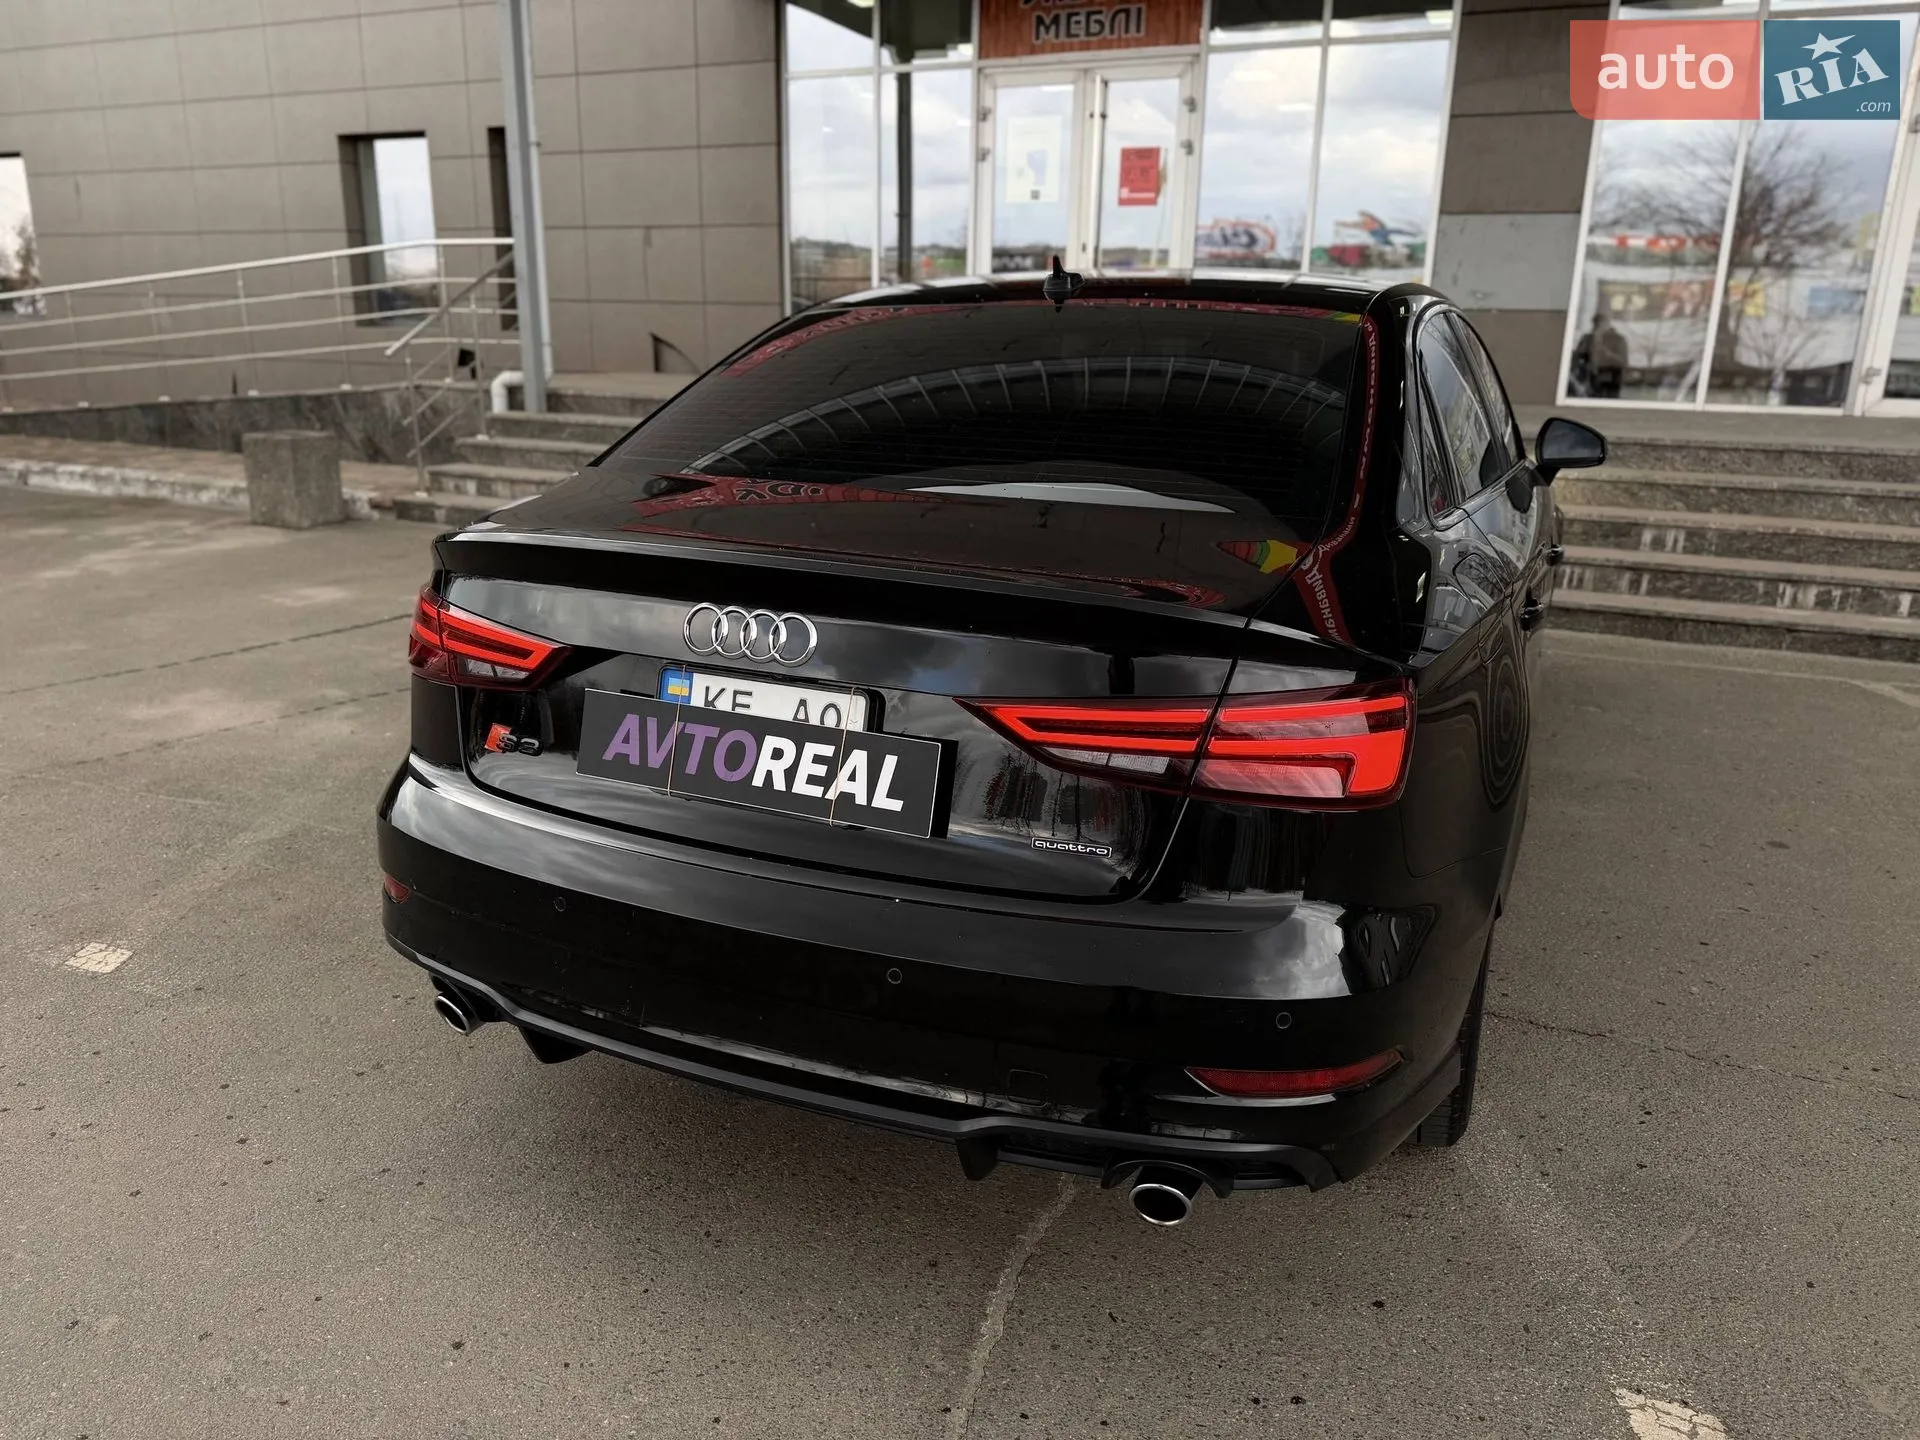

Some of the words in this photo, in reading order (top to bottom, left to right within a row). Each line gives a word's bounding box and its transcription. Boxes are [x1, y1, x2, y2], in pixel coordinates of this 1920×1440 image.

[1034, 6, 1143, 41] МЕБЛІ
[602, 713, 904, 811] AVTOREAL
[1034, 840, 1108, 855] quattro
